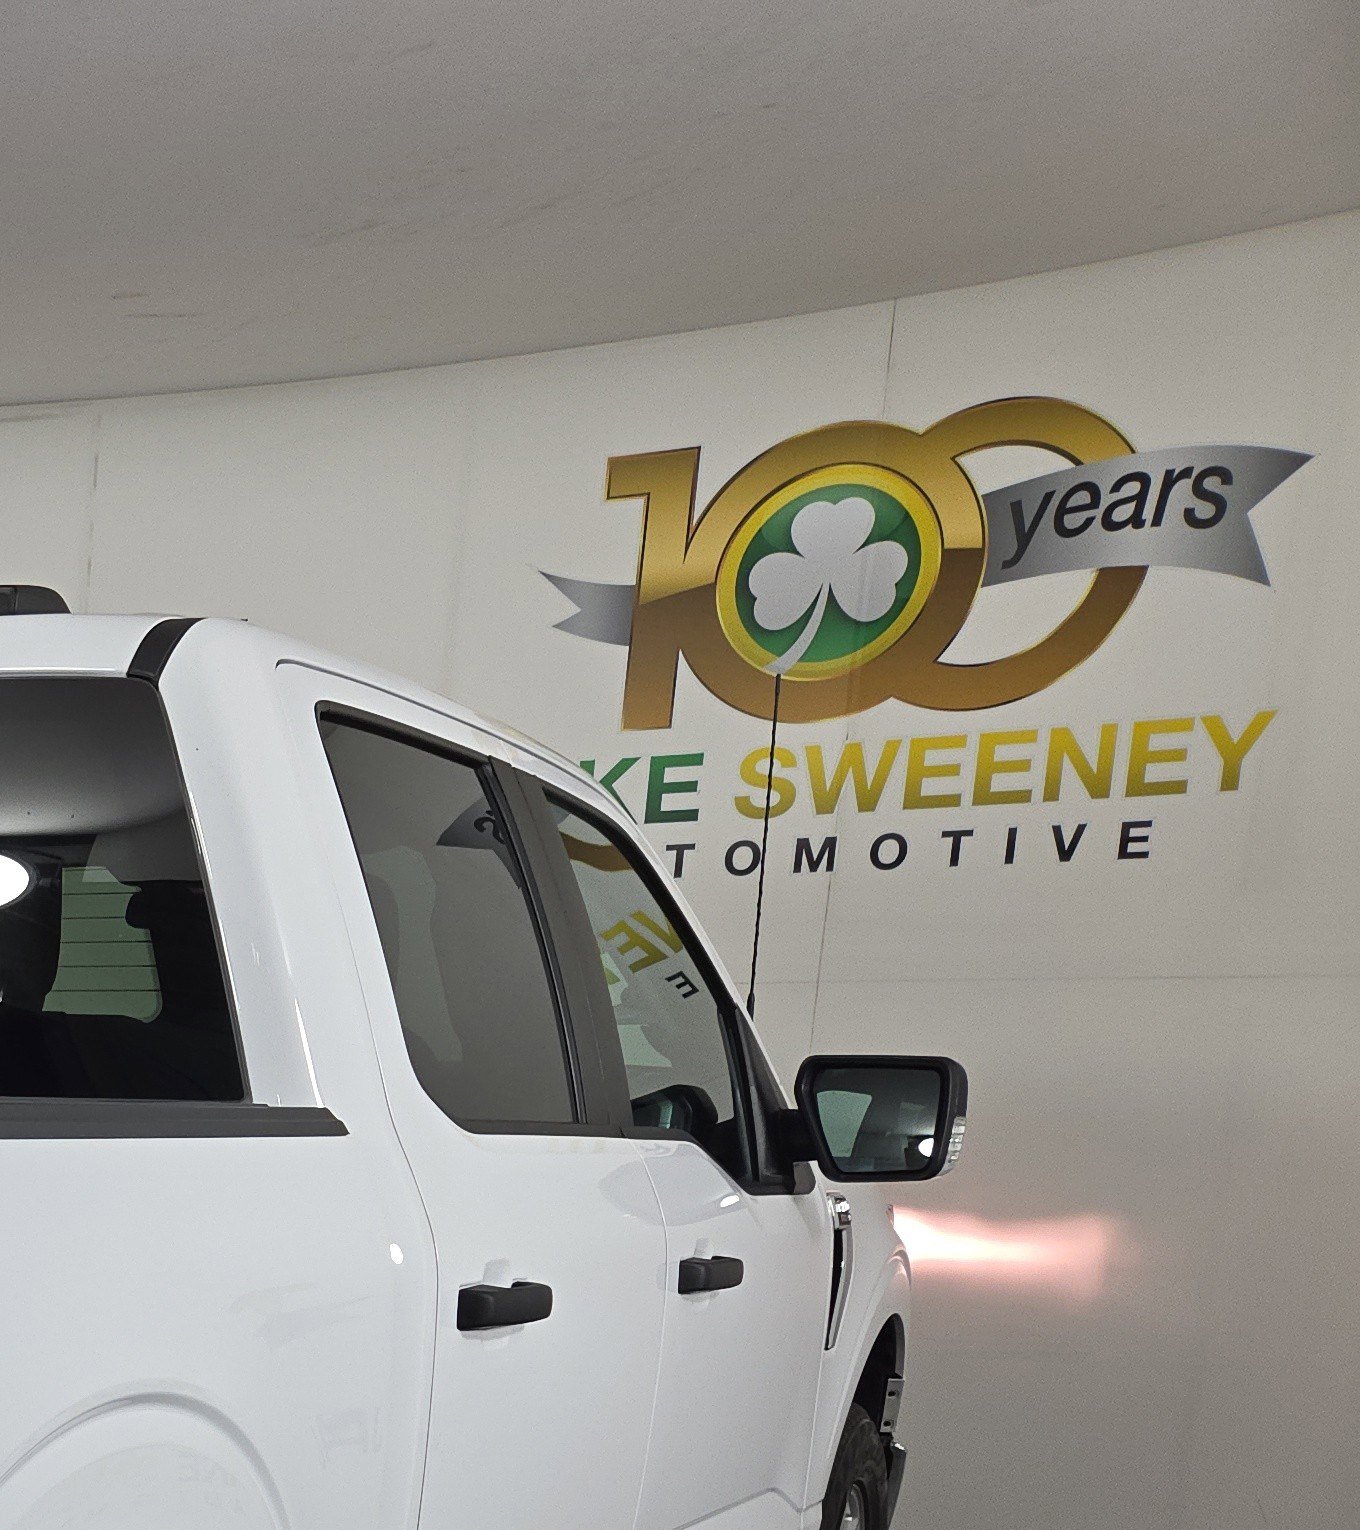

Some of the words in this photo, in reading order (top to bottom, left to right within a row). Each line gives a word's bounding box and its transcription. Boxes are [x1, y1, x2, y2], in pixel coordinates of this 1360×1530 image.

[606, 396, 1151, 731] 100
[999, 463, 1234, 571] years
[734, 709, 1278, 820] SWEENEY
[665, 819, 1154, 879] TOMOTIVE
